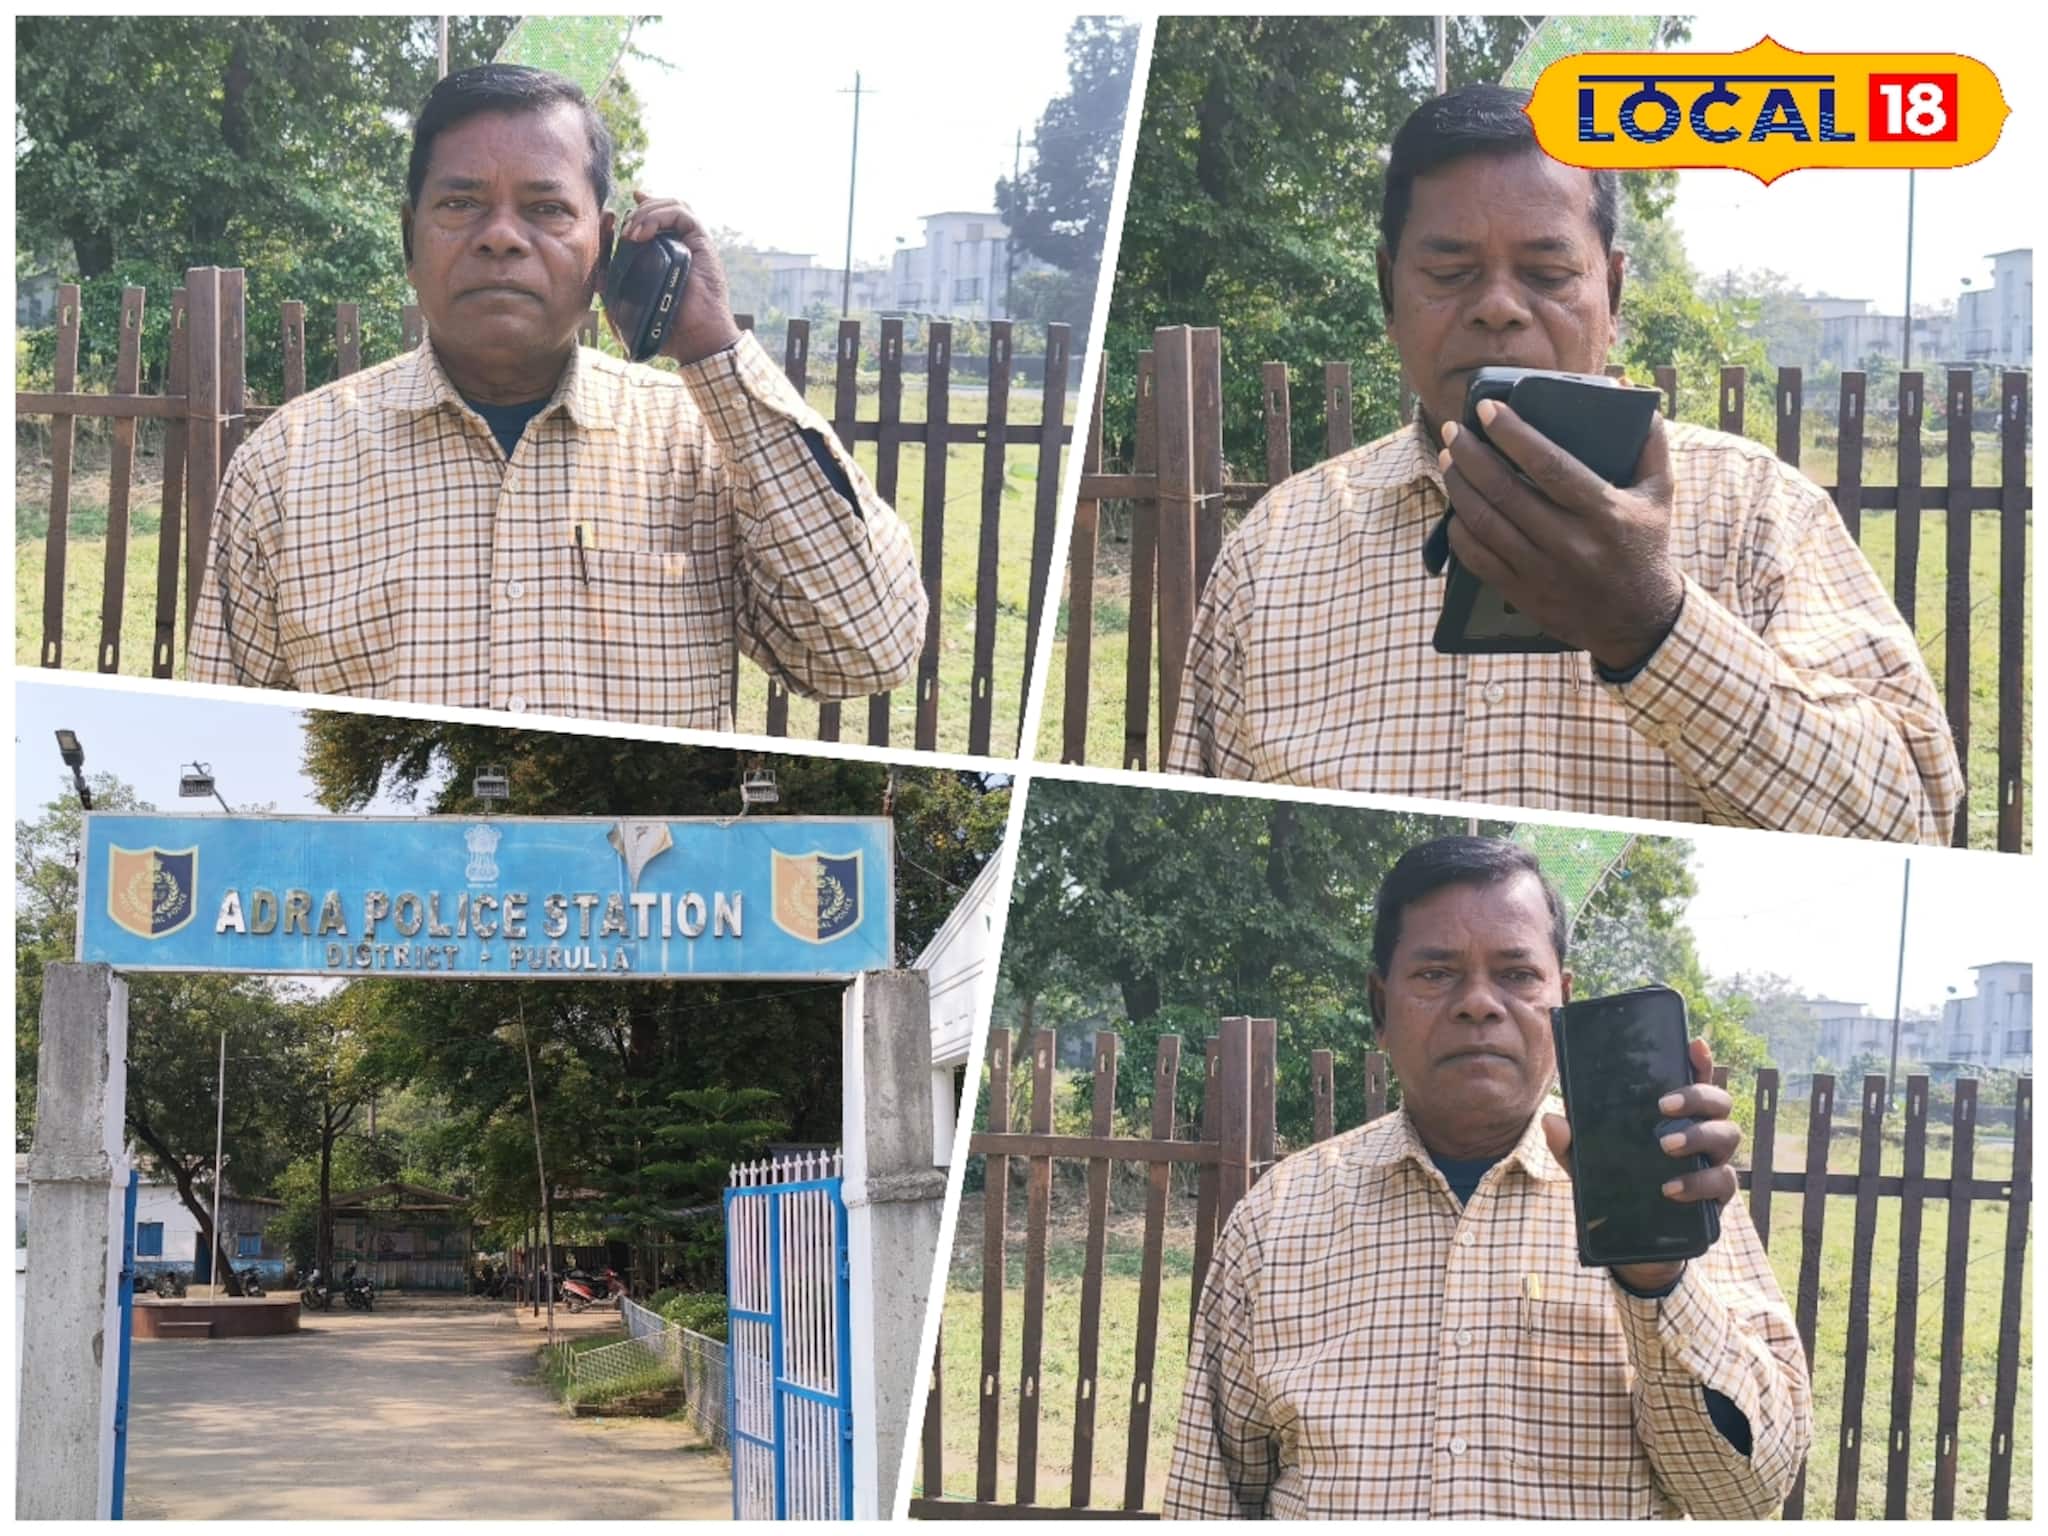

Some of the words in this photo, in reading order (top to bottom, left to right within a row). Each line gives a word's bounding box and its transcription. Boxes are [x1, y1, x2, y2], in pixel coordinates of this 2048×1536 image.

[215, 888, 349, 936] ADRA
[363, 890, 529, 939] POLICE
[543, 890, 744, 939] STATION
[326, 942, 460, 970] DISTRICT
[509, 943, 631, 973] PURULIA
